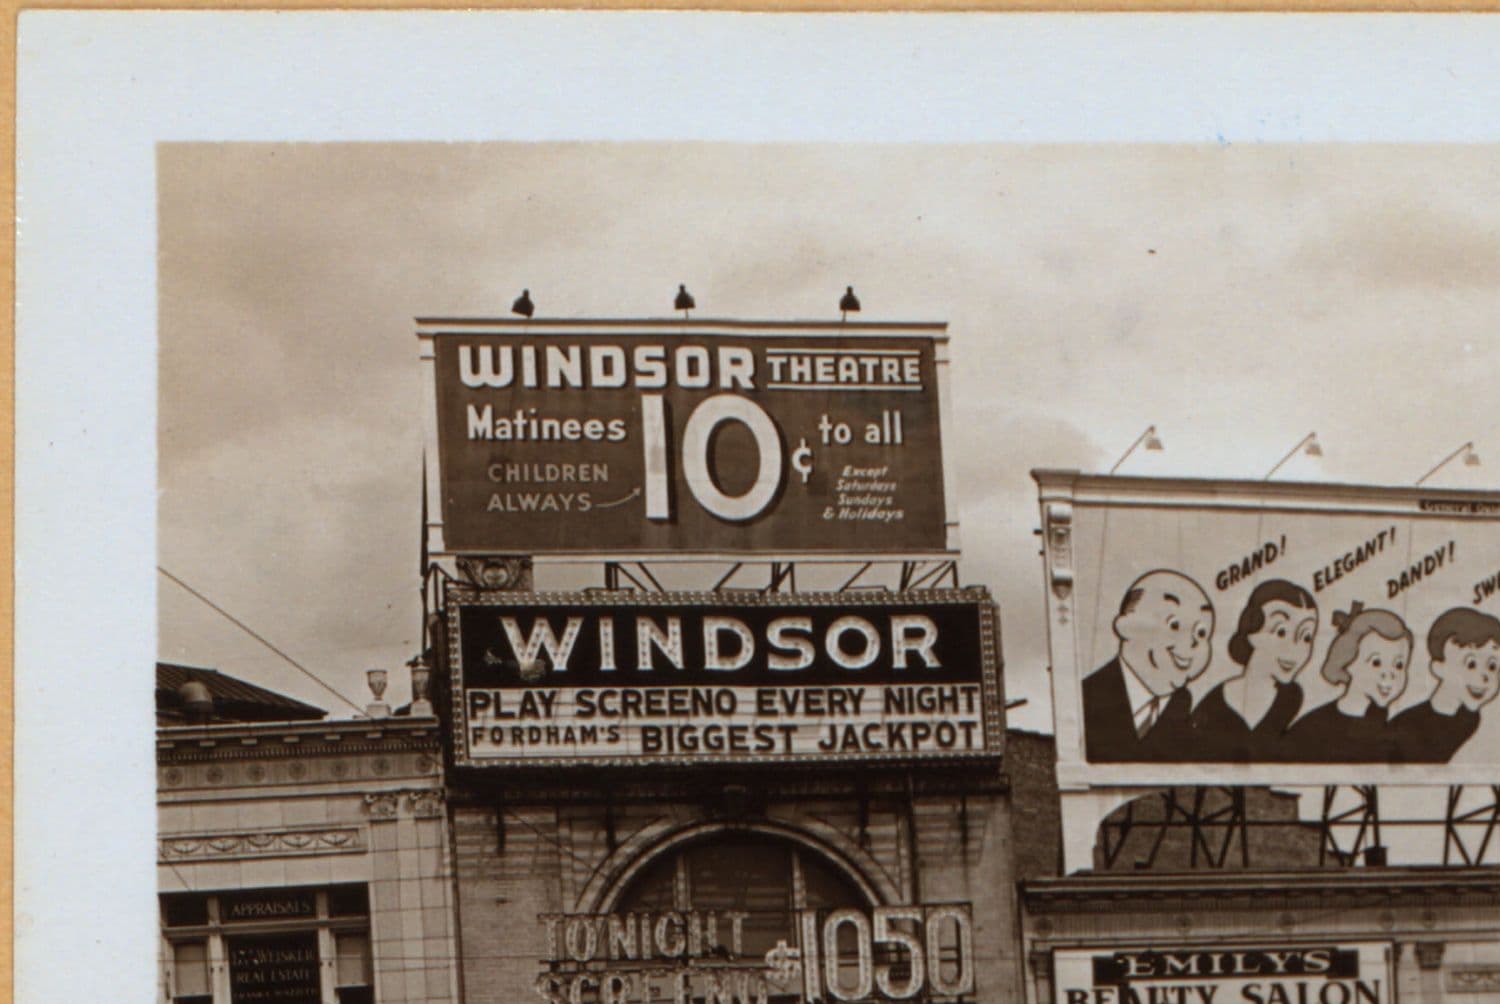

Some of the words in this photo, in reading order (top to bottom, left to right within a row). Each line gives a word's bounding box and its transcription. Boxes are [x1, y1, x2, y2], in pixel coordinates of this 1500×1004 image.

[458, 345, 754, 388] WINDSOR
[767, 356, 920, 383] THEATRE
[467, 404, 626, 441] Matinees
[819, 414, 851, 444] to
[865, 410, 902, 444] all
[488, 463, 609, 483] CHILDREN
[836, 479, 897, 492] Saturdays
[842, 465, 889, 479] Except
[487, 493, 593, 512] ALWAYS
[823, 506, 835, 520] &
[839, 506, 904, 521] Holidays
[838, 493, 894, 506] Sundays
[1215, 535, 1286, 591] GRAND!
[1312, 526, 1396, 593] ELEGANT!
[1386, 541, 1456, 599] DANDY!
[501, 615, 942, 671] WINDSOR
[468, 689, 558, 721] PLAY
[575, 688, 738, 718] SCREENO
[756, 687, 866, 716] EVERY
[883, 686, 978, 714] NIGHT
[471, 725, 621, 746] FORDHAM'S
[641, 724, 798, 753] BIGGEST
[818, 720, 977, 752] JACKPOT
[539, 912, 749, 961] TONIGHT
